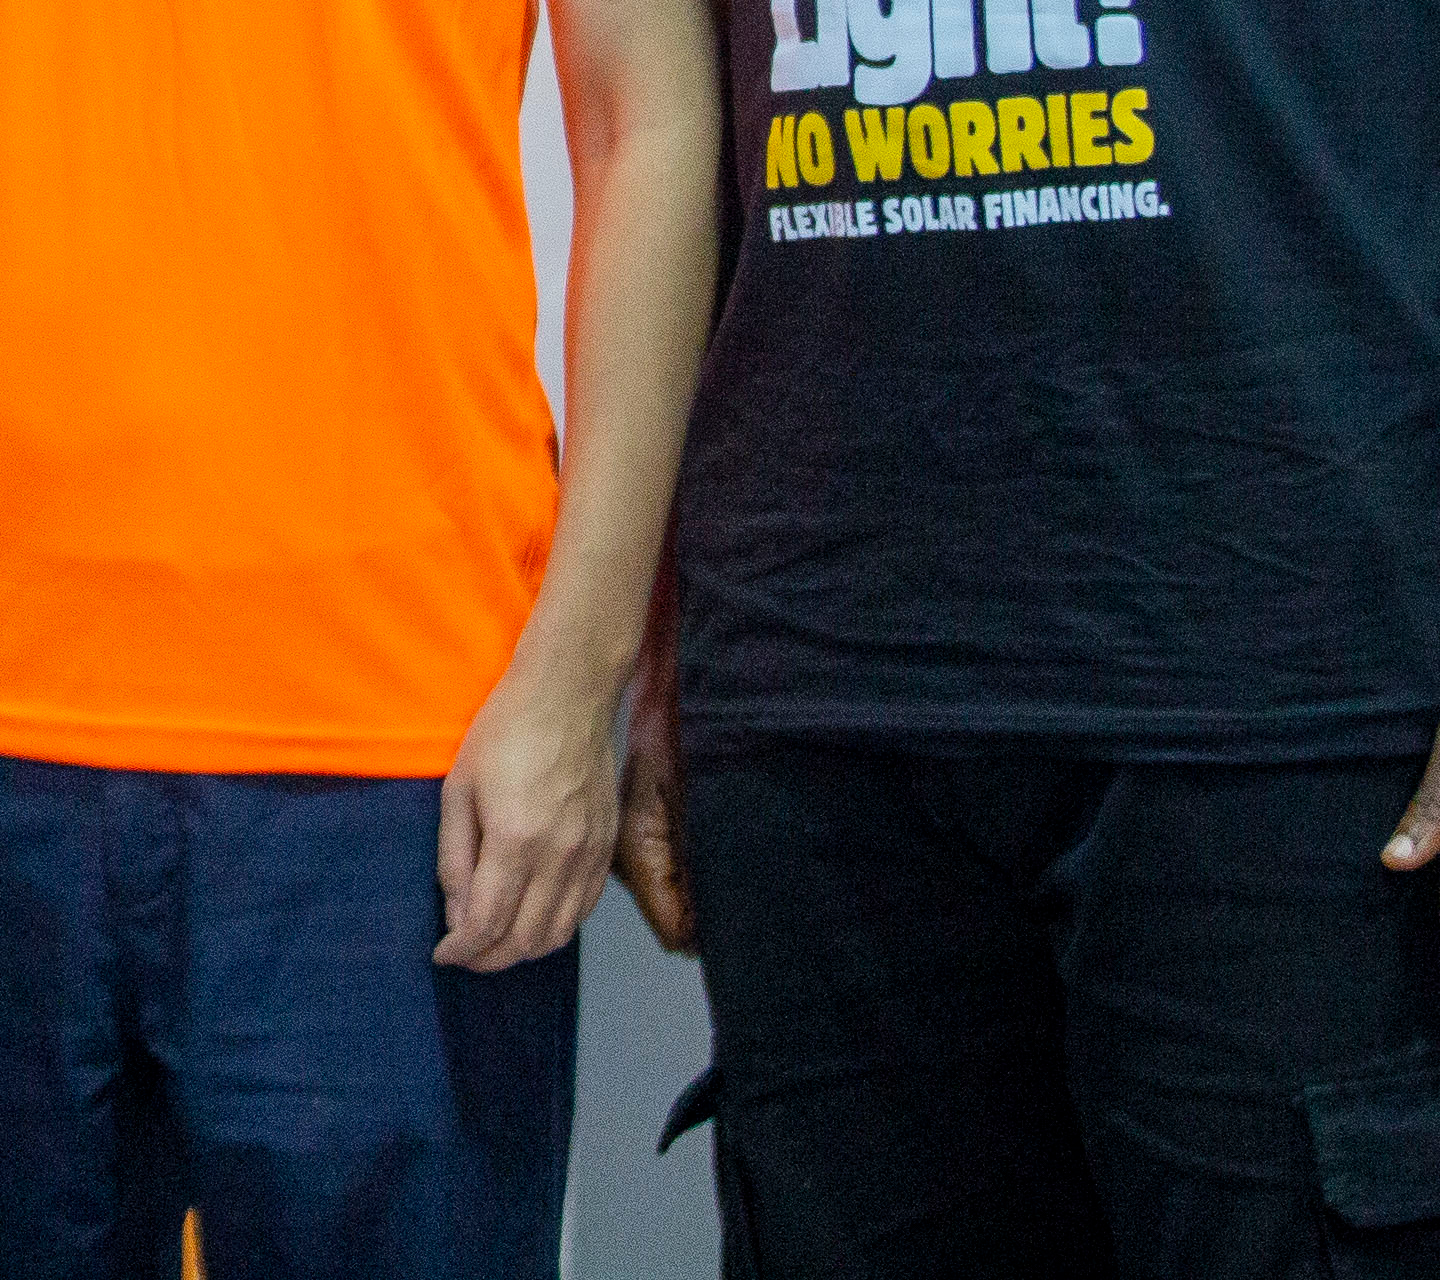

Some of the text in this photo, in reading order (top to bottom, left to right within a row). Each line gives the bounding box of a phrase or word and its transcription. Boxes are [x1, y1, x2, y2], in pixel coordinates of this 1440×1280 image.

[765, 87, 1156, 190] NO WORRIES
[882, 193, 979, 234] SOLAR
[983, 180, 1172, 231] FINANCING.
